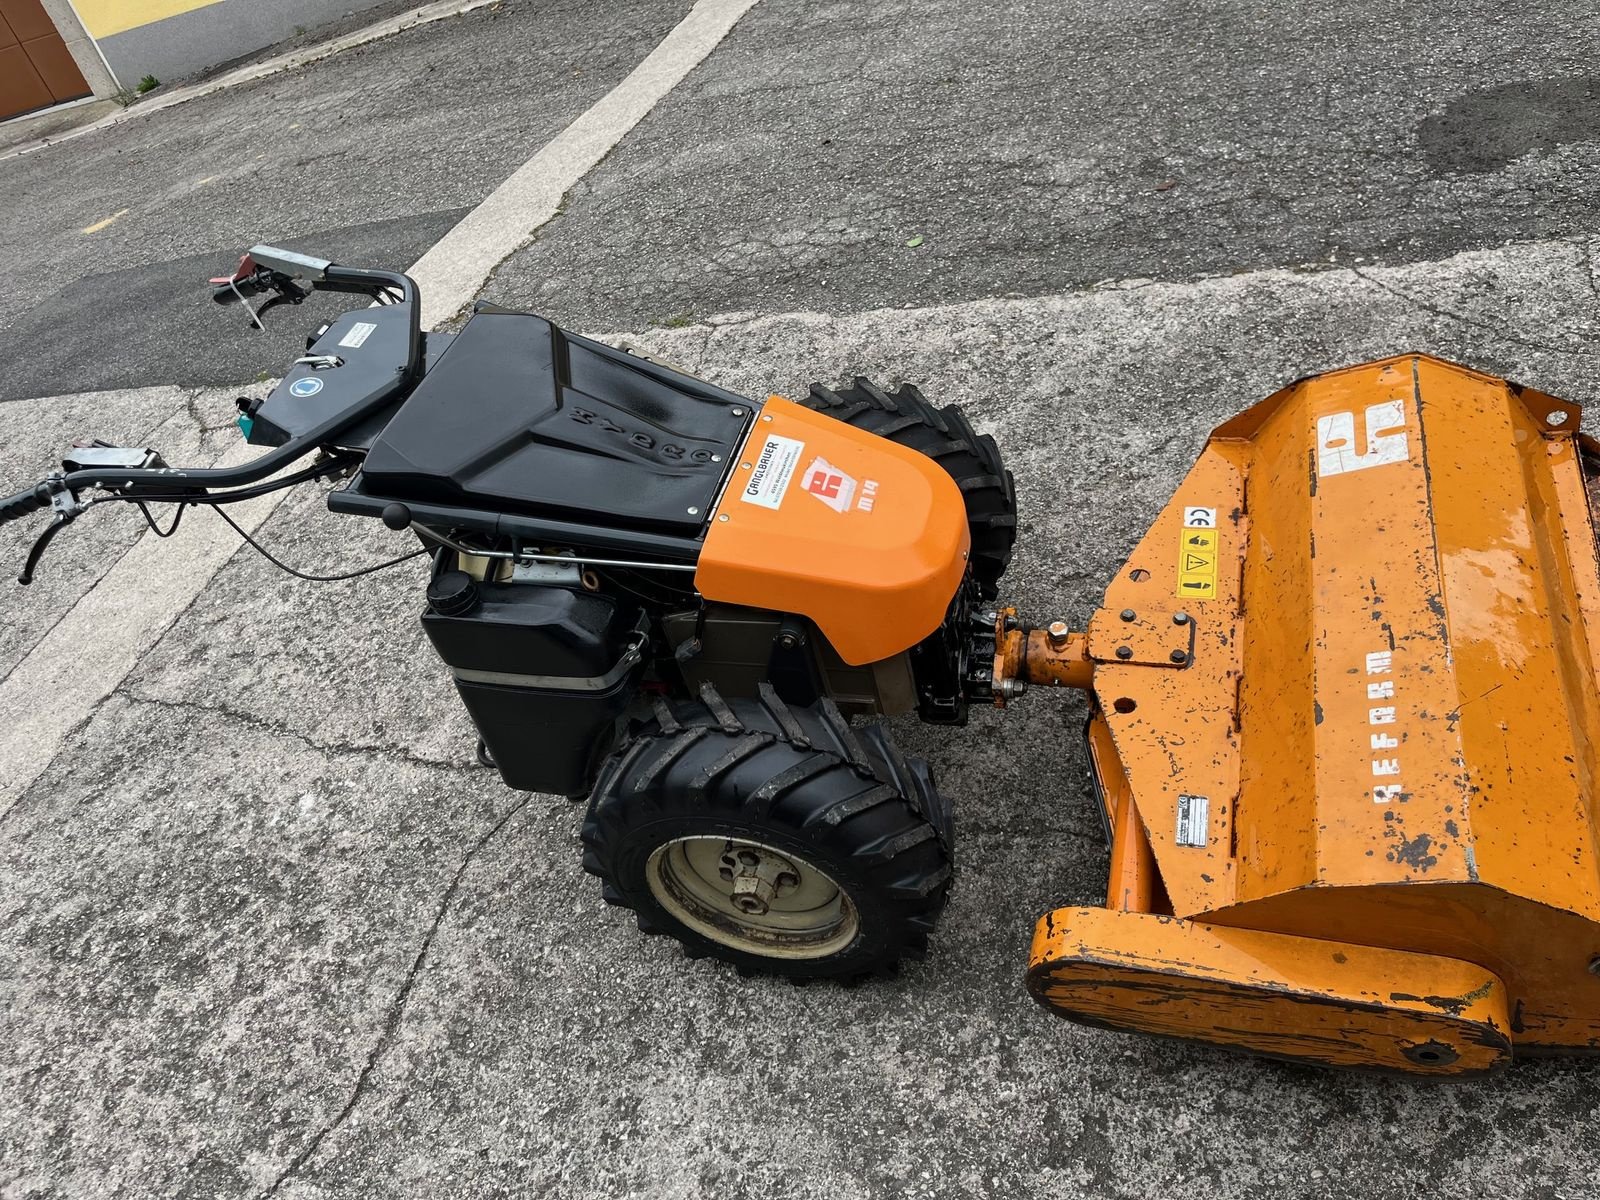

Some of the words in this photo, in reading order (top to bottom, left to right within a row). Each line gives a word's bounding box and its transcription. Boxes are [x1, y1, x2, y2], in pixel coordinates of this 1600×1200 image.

[568, 406, 714, 463] HYDRO
[746, 441, 780, 496] GANGLBAUER
[1189, 508, 1211, 526] CE
